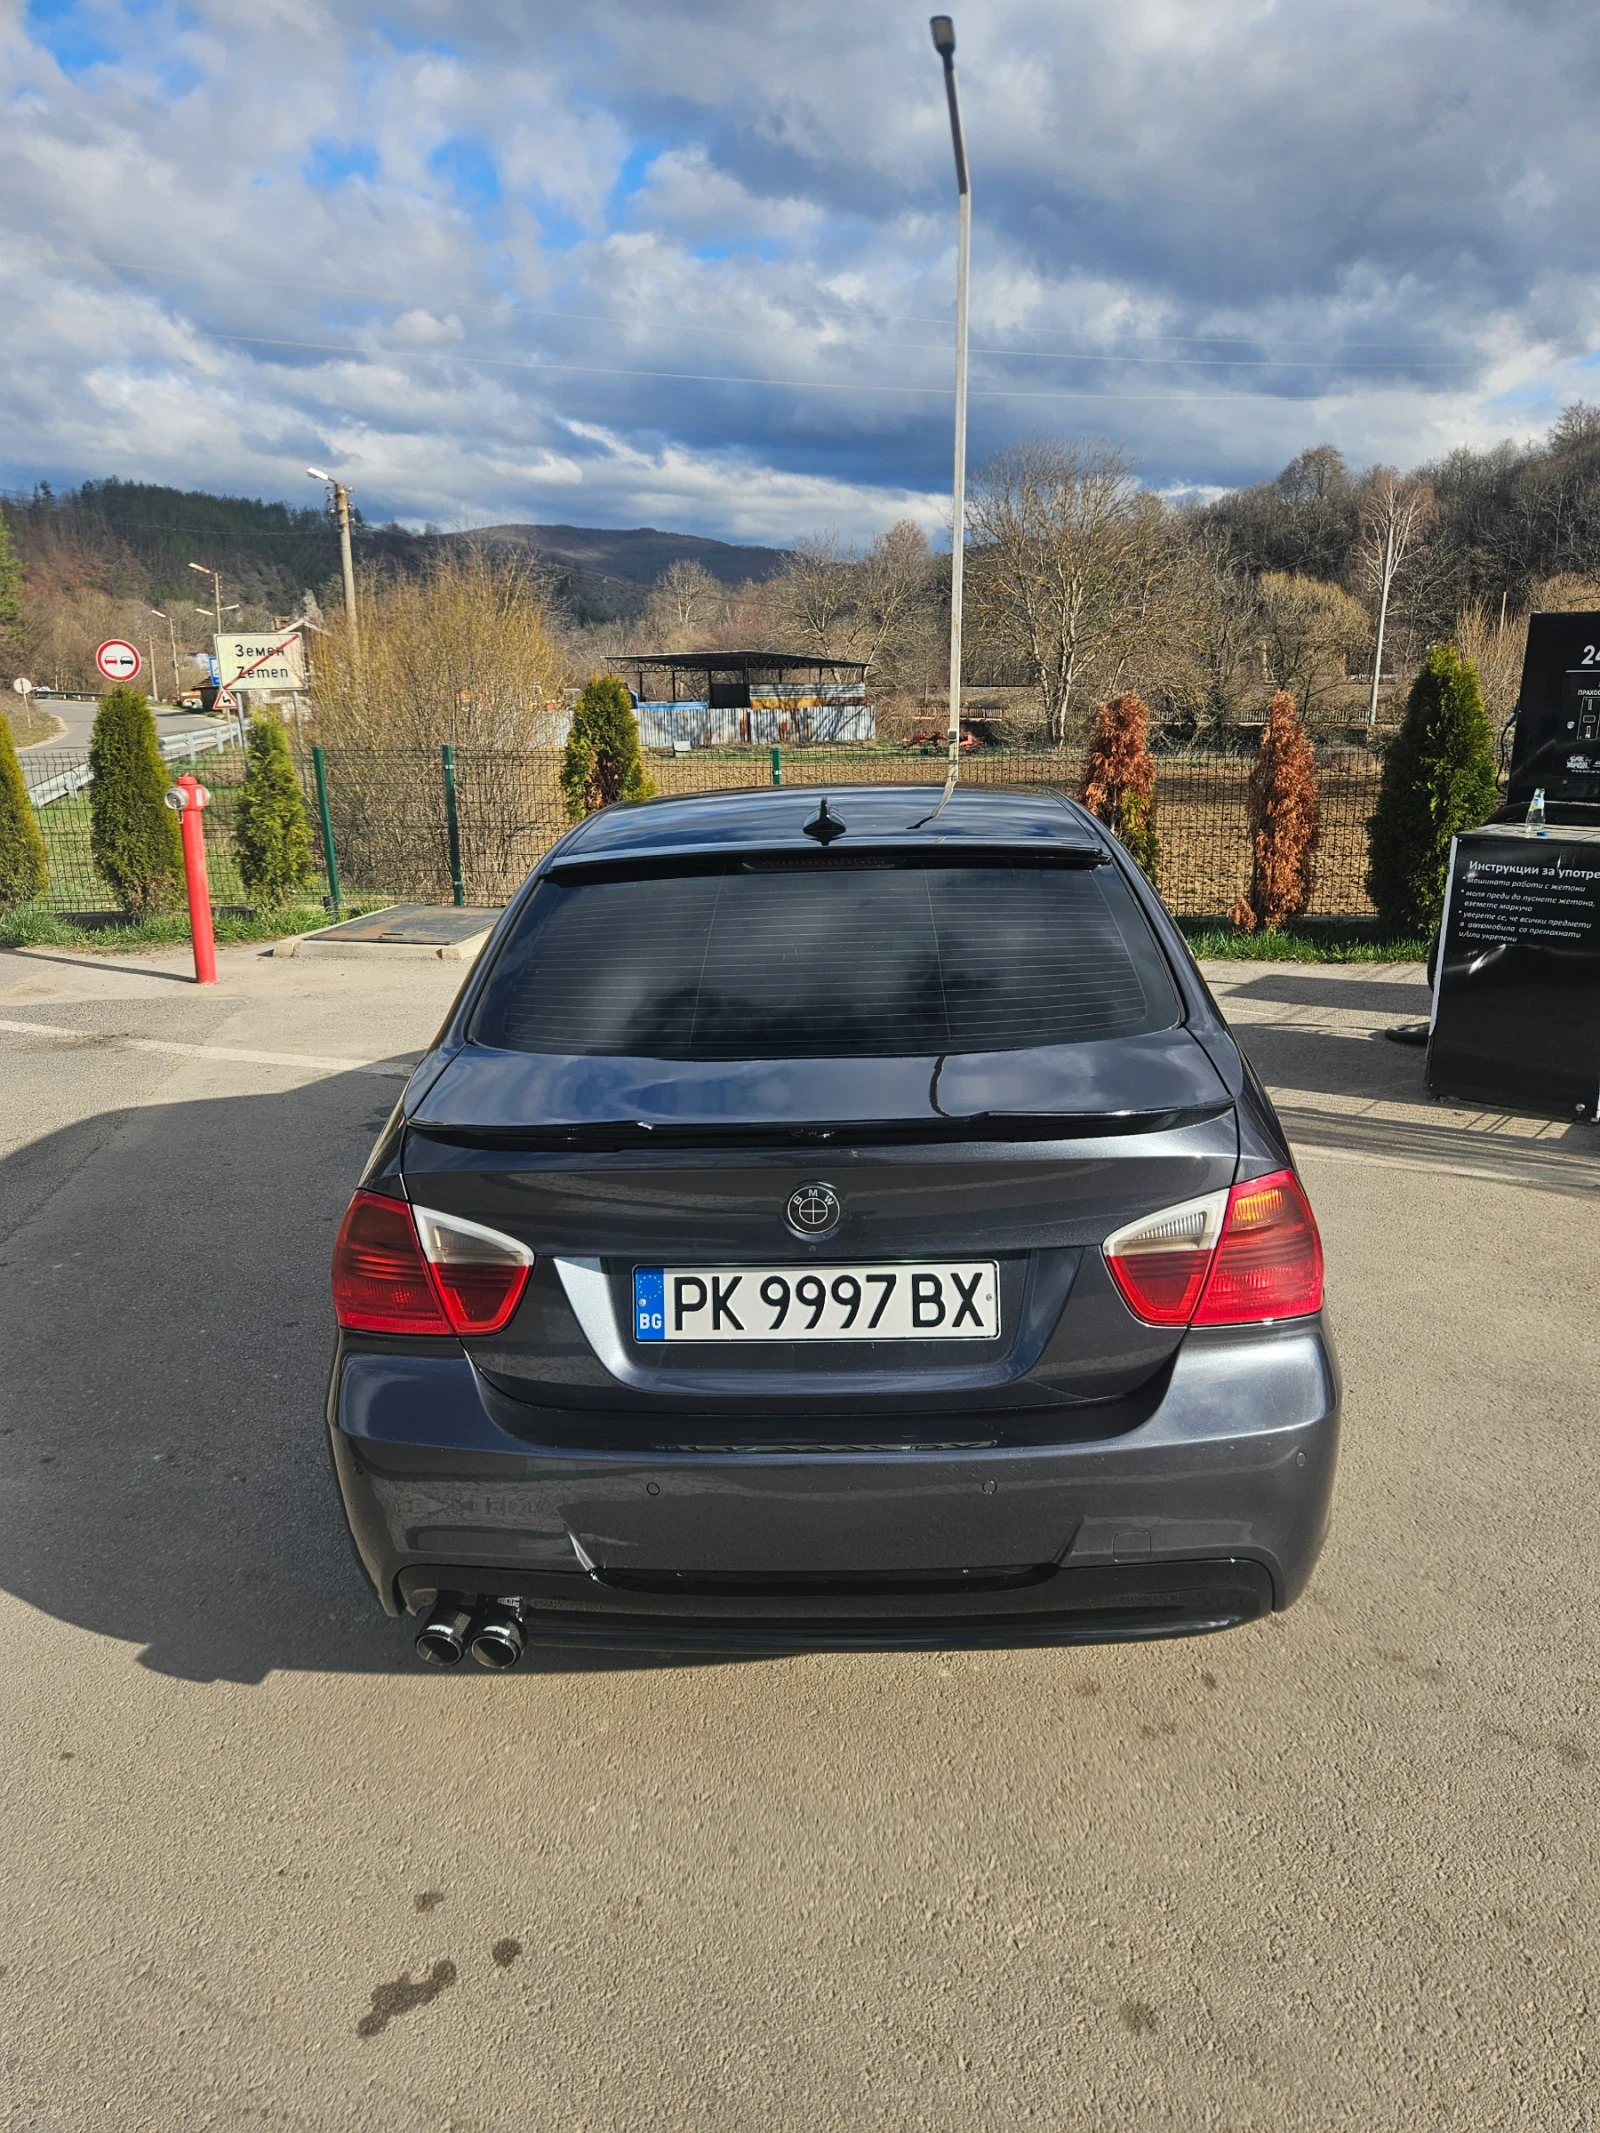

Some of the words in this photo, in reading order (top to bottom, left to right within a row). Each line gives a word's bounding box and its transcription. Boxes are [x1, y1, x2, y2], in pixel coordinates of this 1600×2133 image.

[234, 644, 285, 657] Земен
[236, 666, 289, 679] Zemen
[1469, 860, 1540, 876] Инструкции
[1541, 867, 1555, 876] за
[1466, 878, 1511, 887] машината
[1511, 880, 1544, 889] работи
[1550, 884, 1586, 892] жетони
[1465, 890, 1486, 898] моля
[1486, 891, 1511, 900] преди
[1511, 892, 1522, 901] да
[1522, 895, 1558, 904] пуснете
[1464, 900, 1499, 910] вземете
[1499, 903, 1533, 912] маркуча
[1463, 911, 1497, 920] уверете
[1509, 915, 1519, 923] че
[1519, 916, 1548, 925] всички
[1548, 918, 1592, 929] предмети
[1467, 922, 1516, 932] автомобила
[1529, 928, 1582, 939] премахнати
[1481, 932, 1518, 943] укрепени
[793, 1189, 834, 1205] BMW
[674, 1276, 745, 1331] PK
[759, 1273, 897, 1330] 9997
[911, 1272, 985, 1328] BX
[639, 1313, 662, 1329] BG
